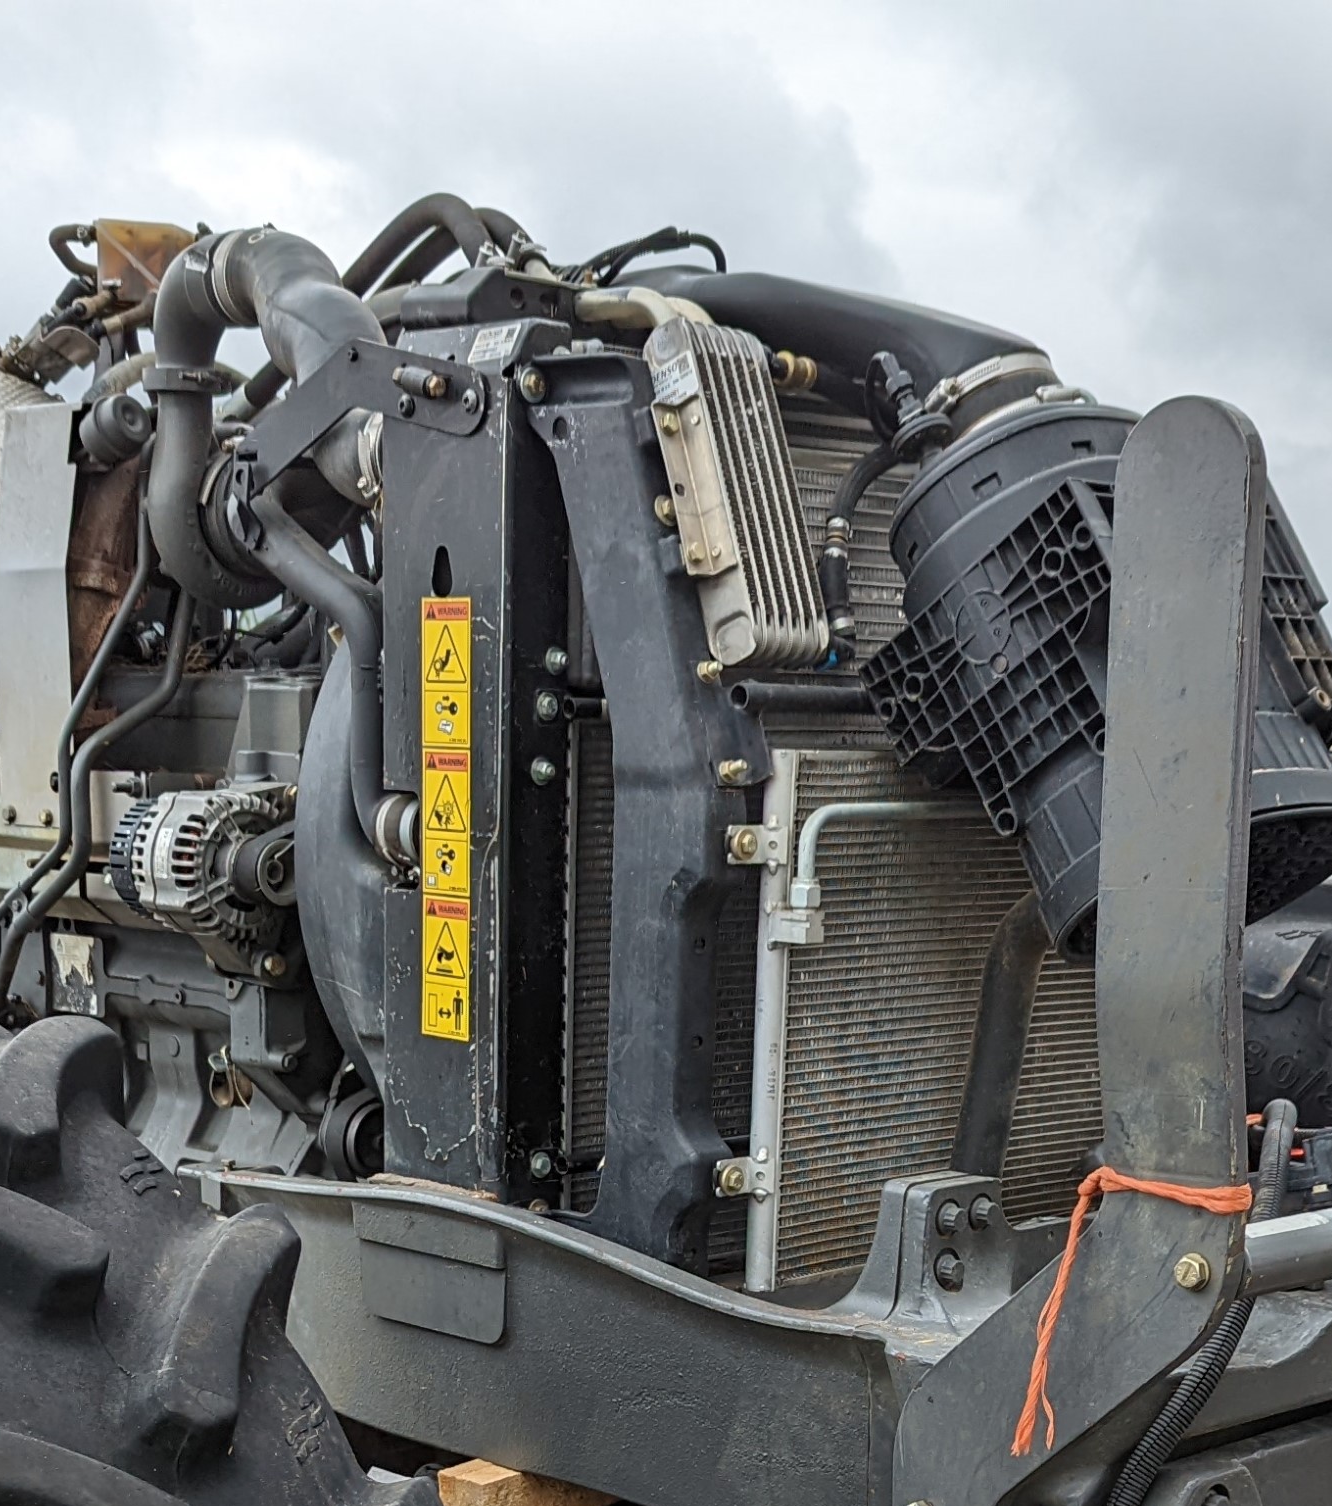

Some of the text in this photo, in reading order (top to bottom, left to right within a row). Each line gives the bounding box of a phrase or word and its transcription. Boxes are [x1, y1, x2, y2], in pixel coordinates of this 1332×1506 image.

[438, 606, 467, 616] WARNING
[438, 757, 467, 768] WARNING
[438, 904, 467, 915] WARNING
